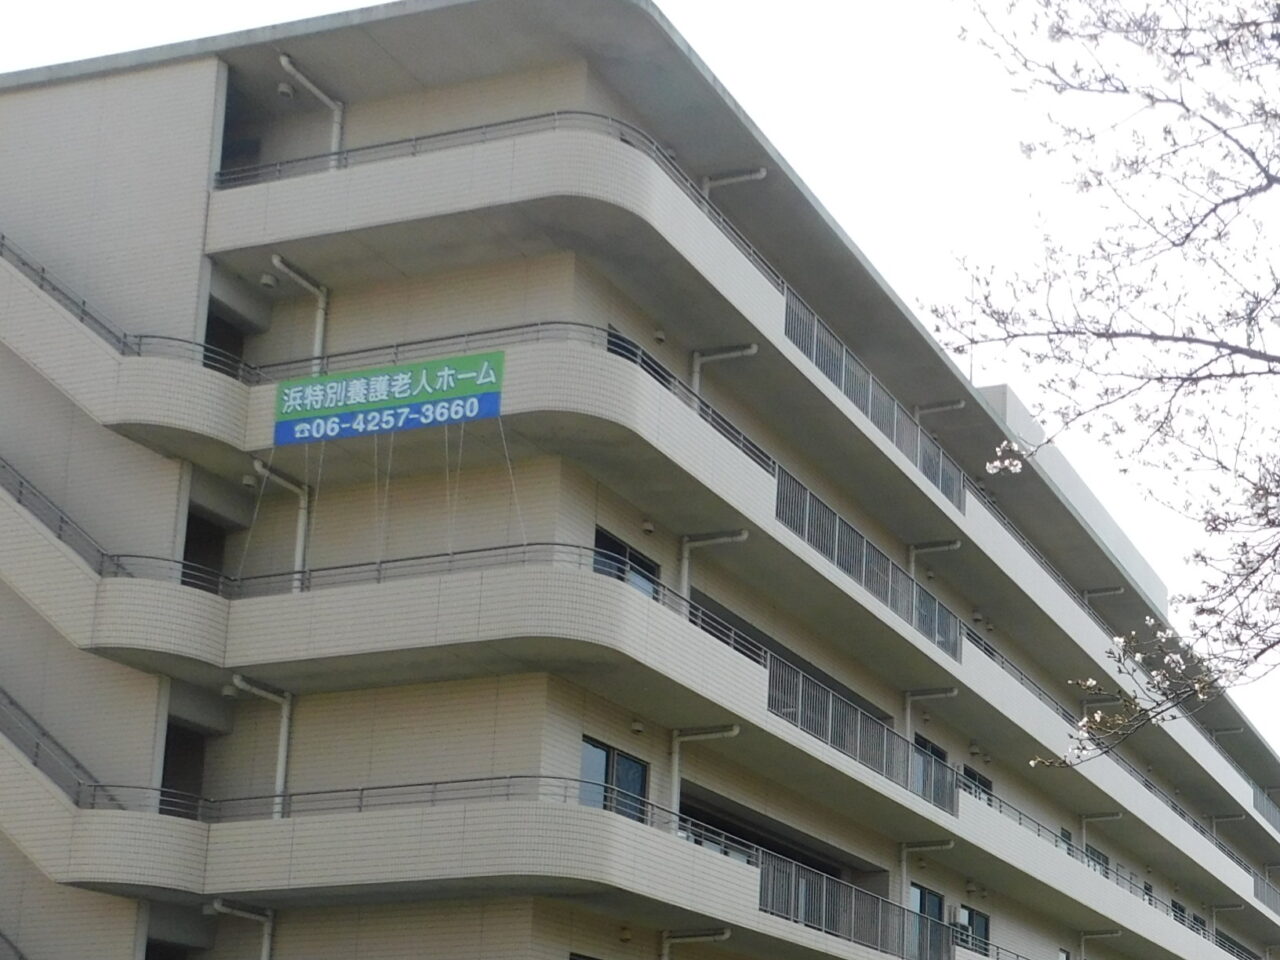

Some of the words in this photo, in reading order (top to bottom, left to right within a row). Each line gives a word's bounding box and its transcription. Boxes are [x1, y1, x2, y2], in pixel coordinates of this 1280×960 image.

[281, 361, 497, 413] 浜特別養護老人ホーム
[312, 397, 479, 438] 06-4257-3660
